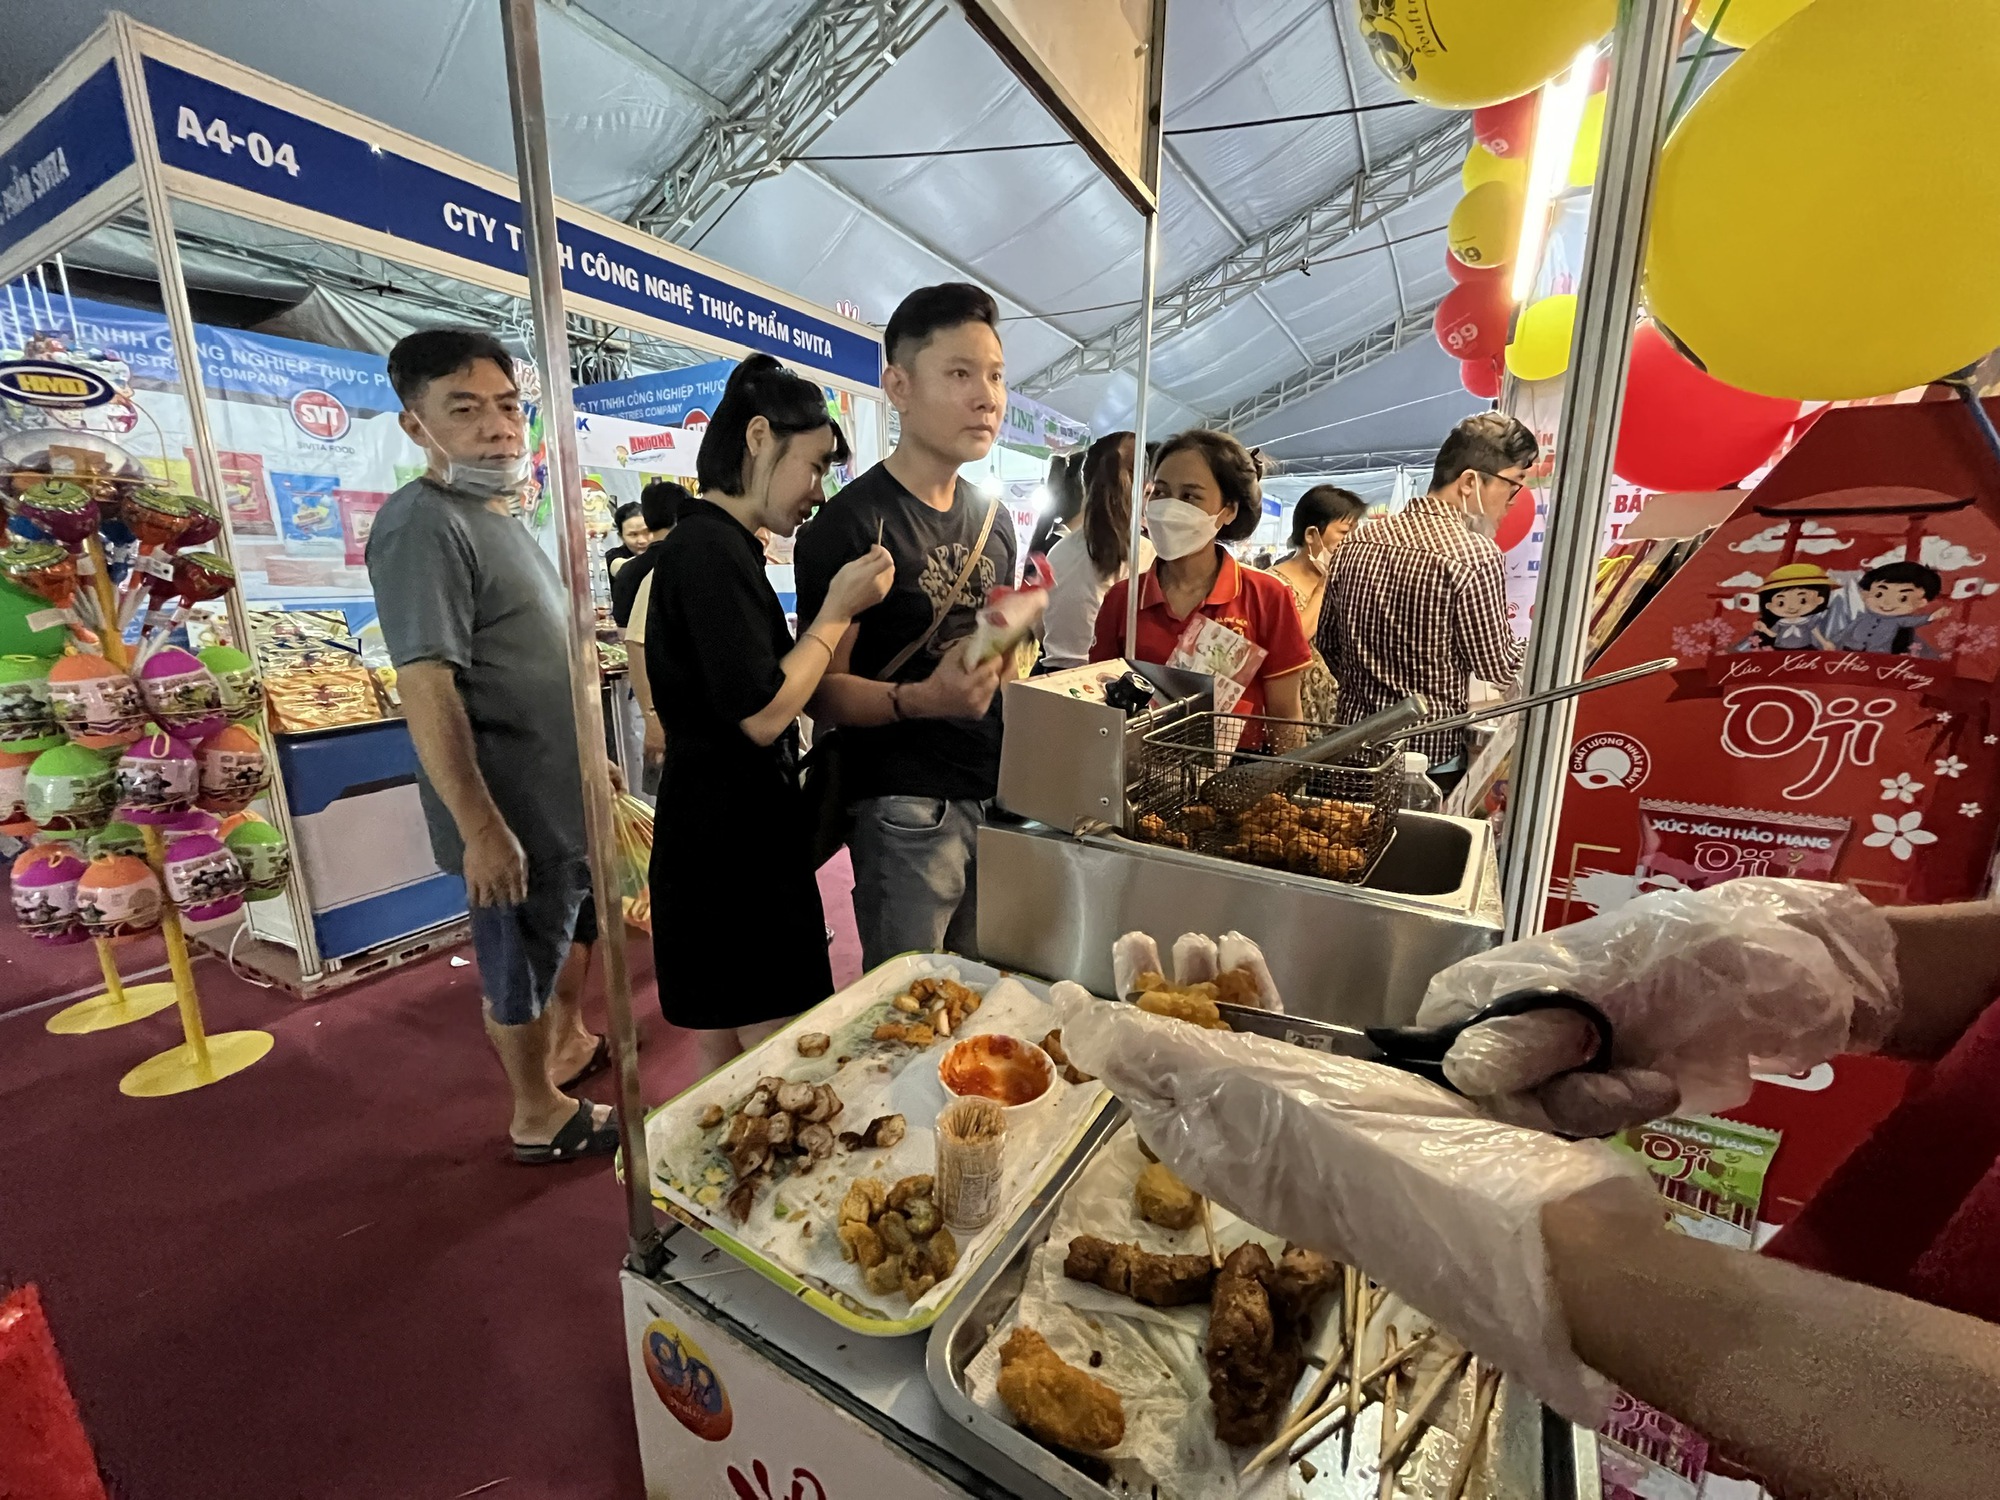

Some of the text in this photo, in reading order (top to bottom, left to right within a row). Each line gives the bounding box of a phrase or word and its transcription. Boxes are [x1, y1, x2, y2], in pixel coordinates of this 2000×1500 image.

[178, 106, 300, 177] A4-04
[443, 202, 833, 359] CTY TH CÔNG NGHỆ THỰC PHẨM SIVITA
[208, 365, 290, 388] COMPANY
[600, 397, 626, 411] TNHH
[627, 390, 654, 407] CÔNG
[656, 384, 694, 401] NGHIỆP
[645, 403, 683, 418] COMPANY
[300, 404, 339, 427] SVT
[1573, 746, 1589, 770] CHẤT
[1586, 737, 1625, 749] LƯỢNG
[1720, 685, 1897, 800] Oji
[1652, 818, 1689, 833] XÚC
[1691, 822, 1731, 839] XÍCH
[1733, 826, 1774, 843] HẢO
[1641, 1132, 1713, 1181] Oji
